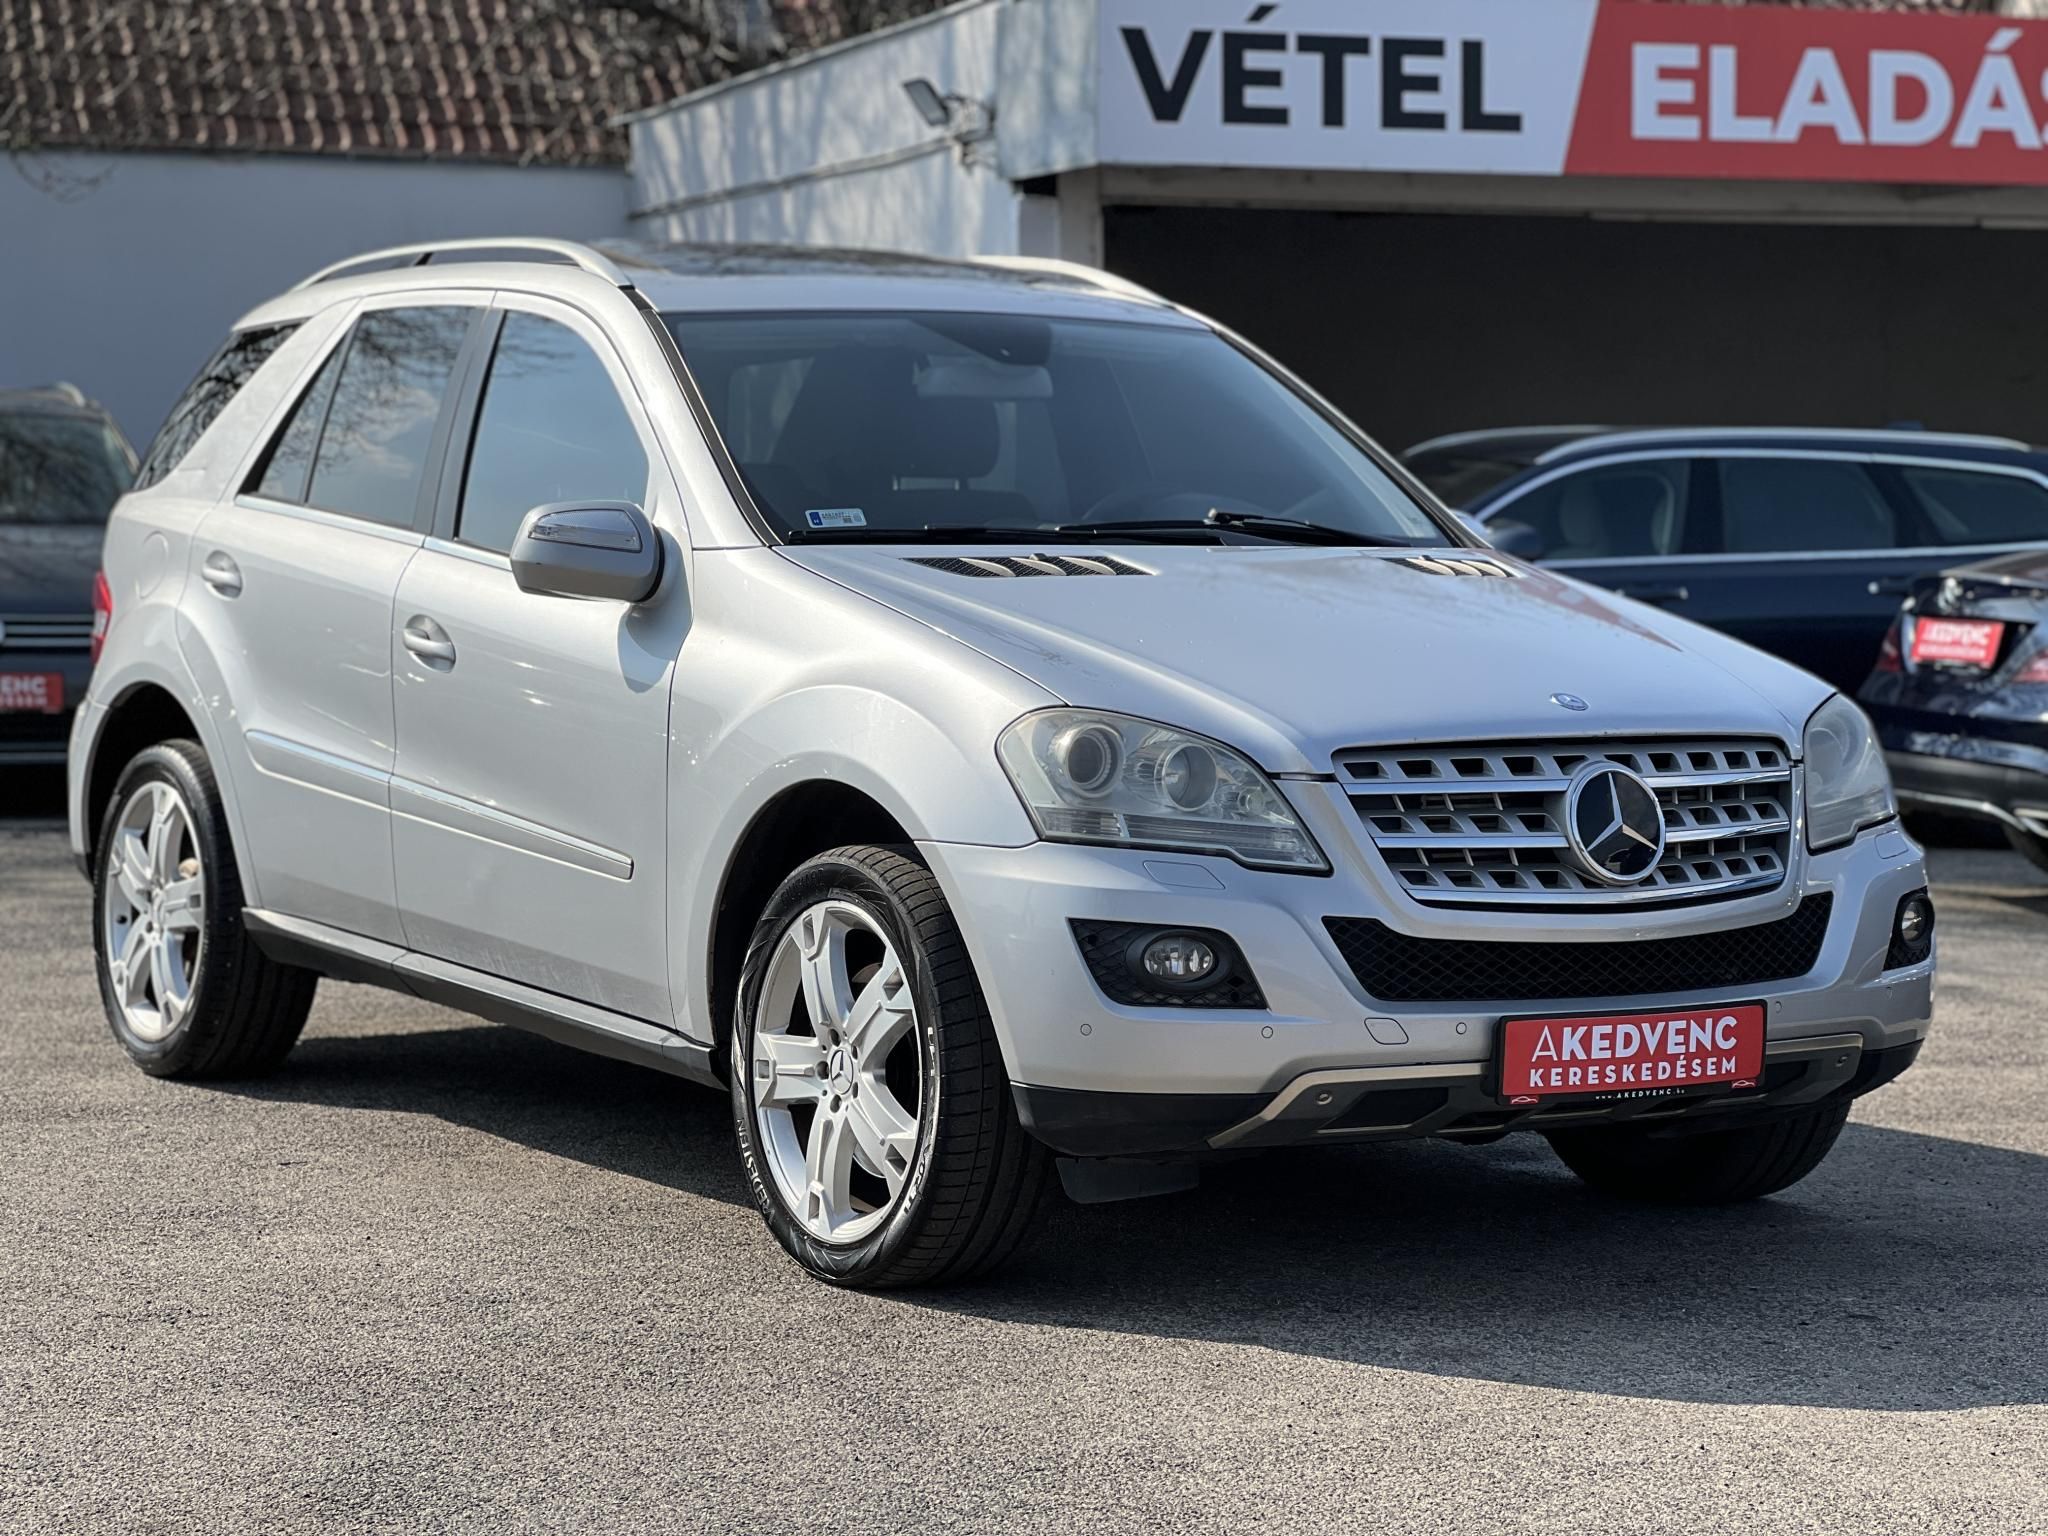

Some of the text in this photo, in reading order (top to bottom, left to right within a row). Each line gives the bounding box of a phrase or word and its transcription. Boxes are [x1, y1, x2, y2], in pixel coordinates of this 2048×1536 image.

[1120, 4, 1523, 133] VÉTEL
[1631, 27, 2048, 149] ELADÁ
[1529, 1055, 1737, 1088] KERESKEDÉSEM
[1531, 1016, 1738, 1062] AKEDVENC
